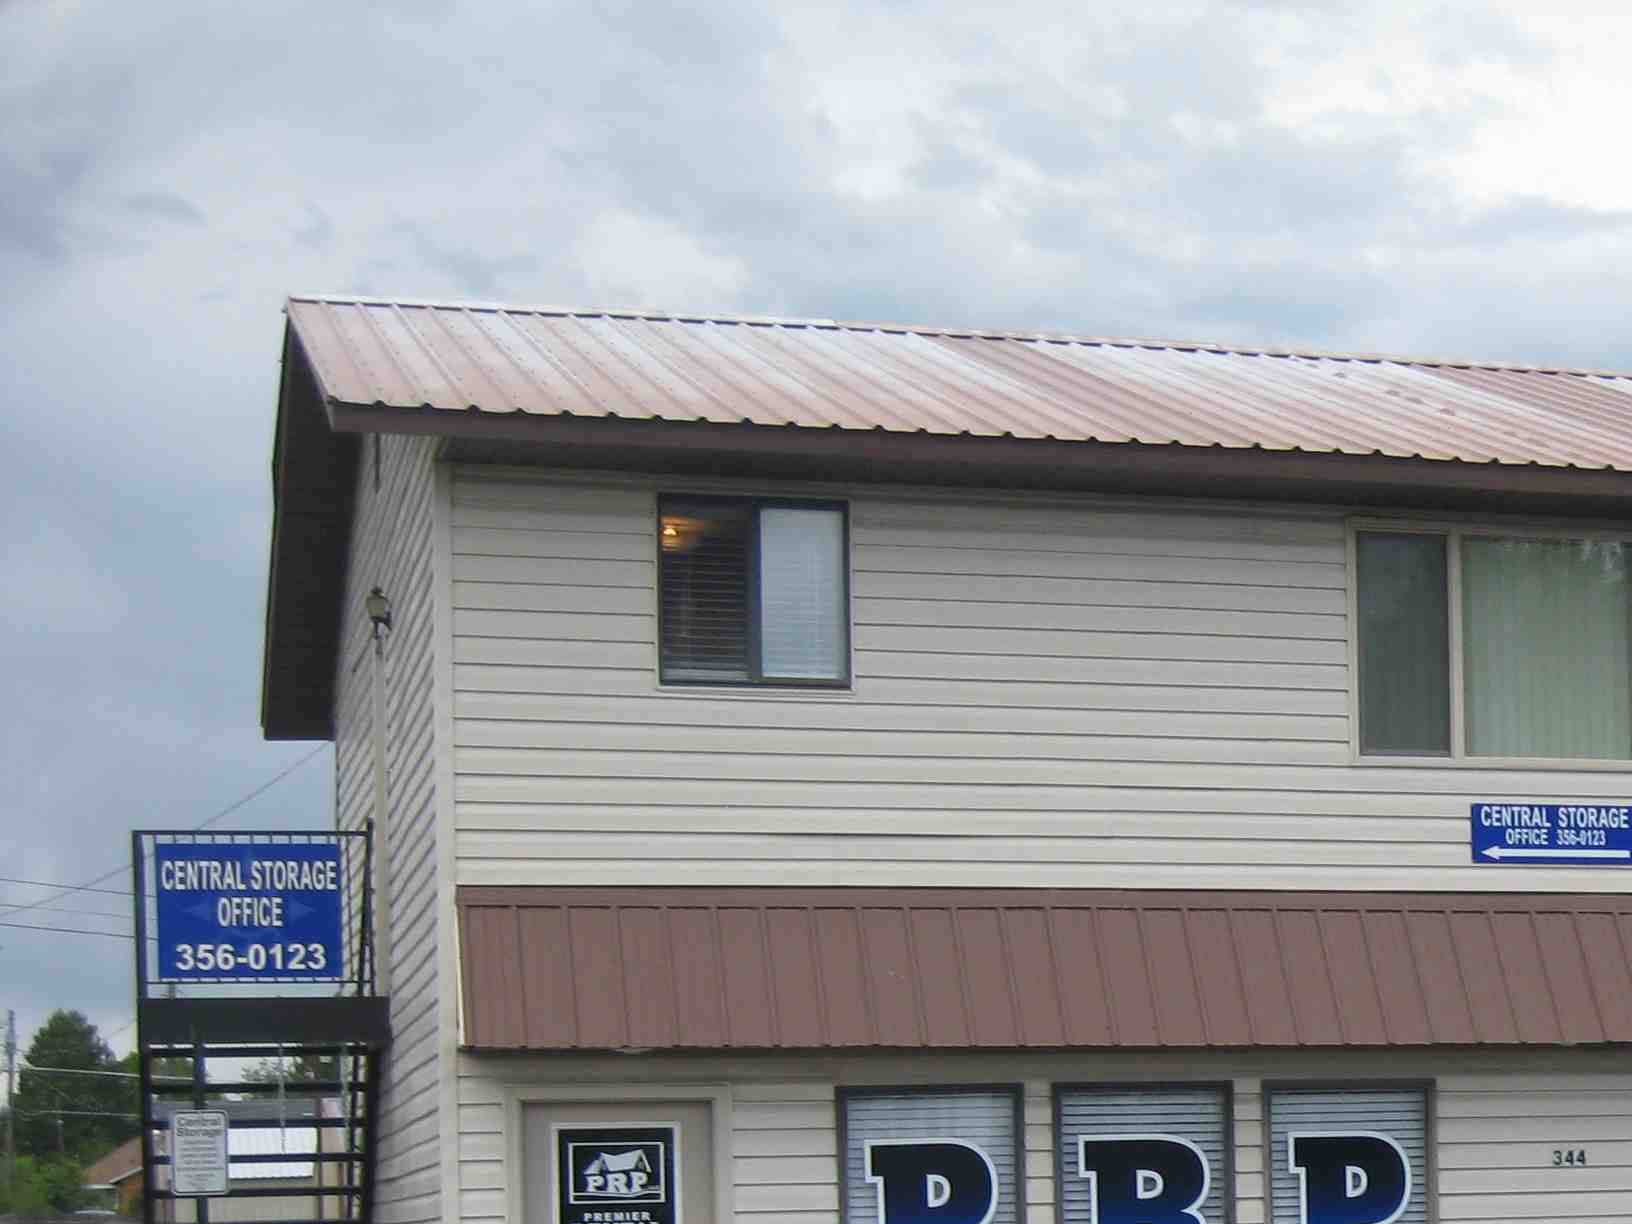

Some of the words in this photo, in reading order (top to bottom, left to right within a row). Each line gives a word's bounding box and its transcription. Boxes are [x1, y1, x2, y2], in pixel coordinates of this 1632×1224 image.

[1480, 806, 1551, 827] CENTRAL
[1558, 808, 1630, 829] STORAGE
[1505, 828, 1549, 845] OFFICE
[1556, 829, 1606, 846] 356-0123
[161, 860, 246, 890] CENTRAL
[250, 860, 337, 890] STORAGE
[217, 897, 283, 927] OFFICE
[175, 943, 327, 971] 356-0123
[1551, 1150, 1586, 1167] 344
[585, 1171, 649, 1194] PRP
[583, 1211, 651, 1223] PREMIER
